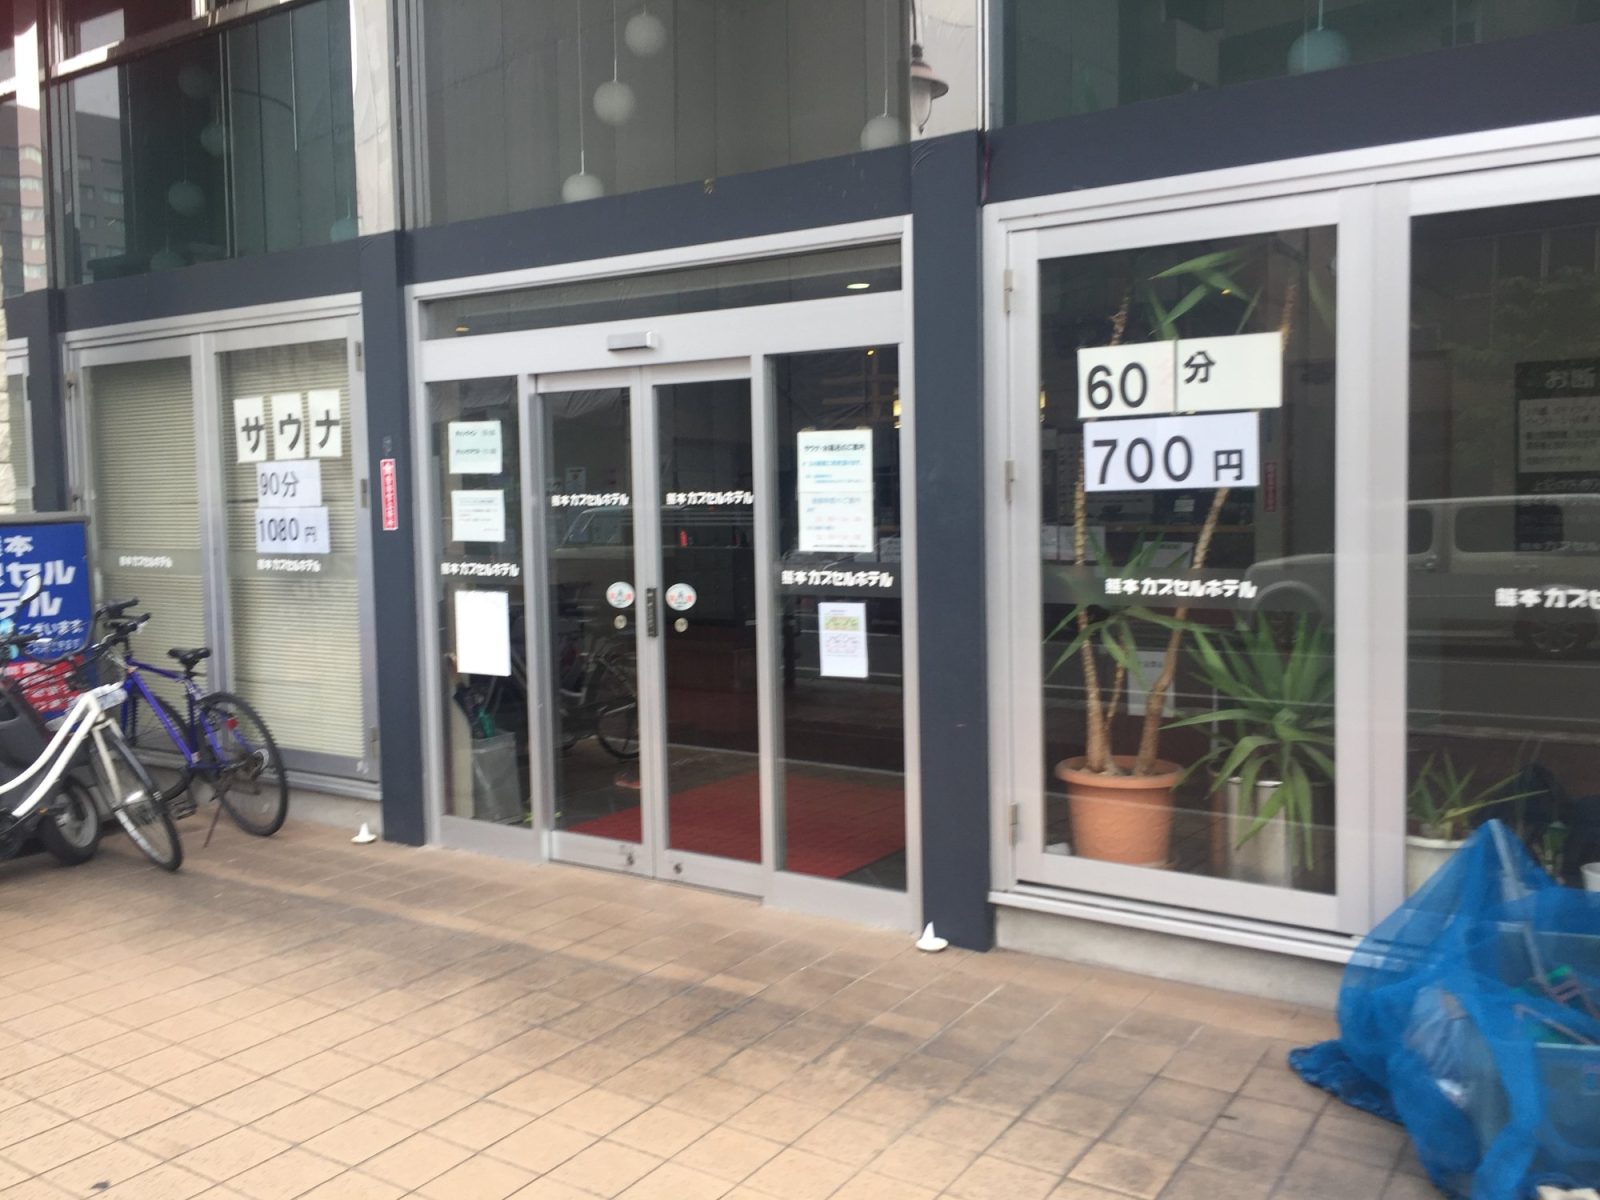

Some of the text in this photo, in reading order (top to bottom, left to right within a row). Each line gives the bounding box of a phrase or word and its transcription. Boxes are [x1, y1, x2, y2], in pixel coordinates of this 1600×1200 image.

[241, 409, 340, 453] サウナ
[260, 470, 299, 498] 90分
[1104, 577, 1257, 600] 熊本カプセルホテル
